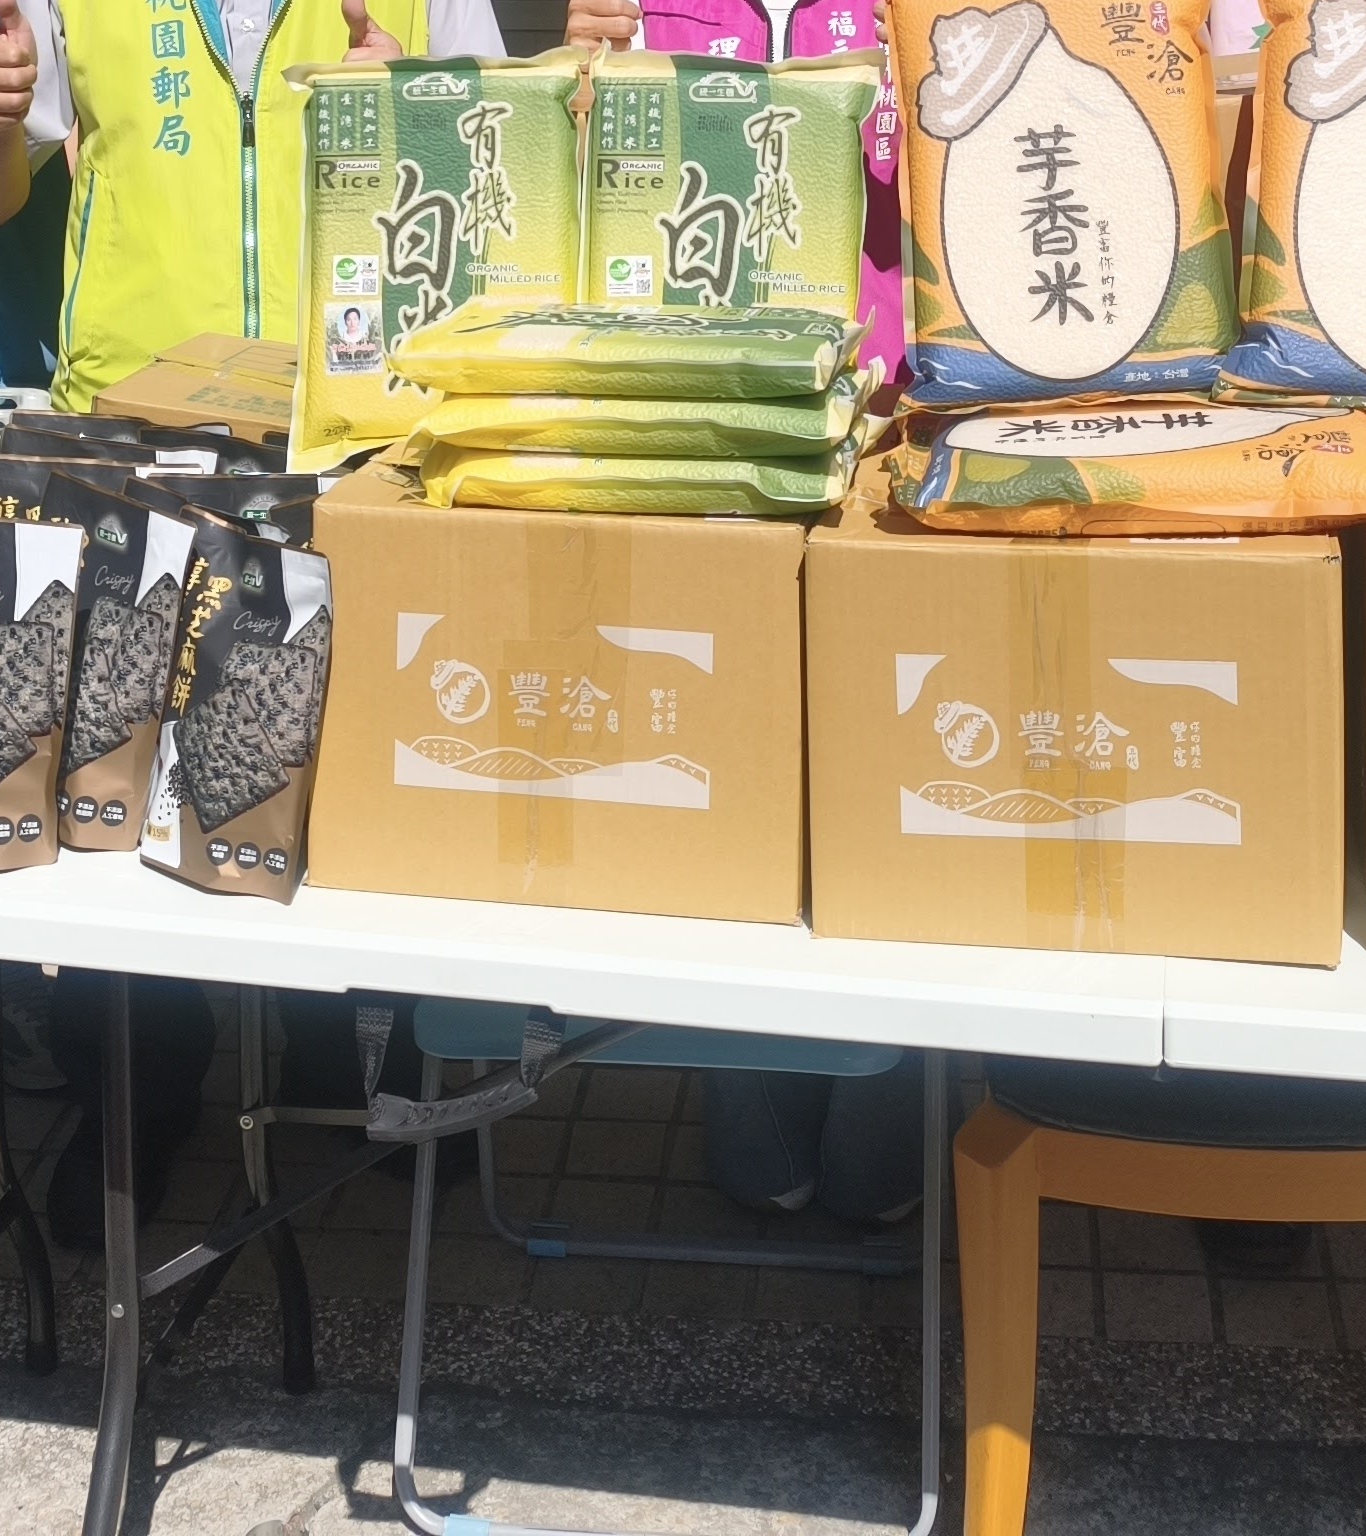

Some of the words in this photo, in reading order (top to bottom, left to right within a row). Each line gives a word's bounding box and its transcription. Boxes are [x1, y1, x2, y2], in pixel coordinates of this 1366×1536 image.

[315, 161, 380, 189] Rice
[461, 105, 514, 250] 有機
[597, 159, 664, 189] Rice
[748, 111, 798, 256] 有機
[1014, 124, 1095, 325] 芋香米
[467, 263, 519, 273] ORGANIC
[490, 274, 531, 284] MILLED
[535, 274, 561, 283] RICE
[749, 270, 803, 281] ORGANIC
[772, 282, 815, 293] MILLED
[819, 283, 846, 293] RICE
[96, 566, 136, 594] Crispy
[234, 611, 282, 637] Crispy
[172, 576, 233, 717] 黑芝麻餅
[508, 672, 612, 718] 豐滄
[1018, 710, 1130, 757] 豐滄
